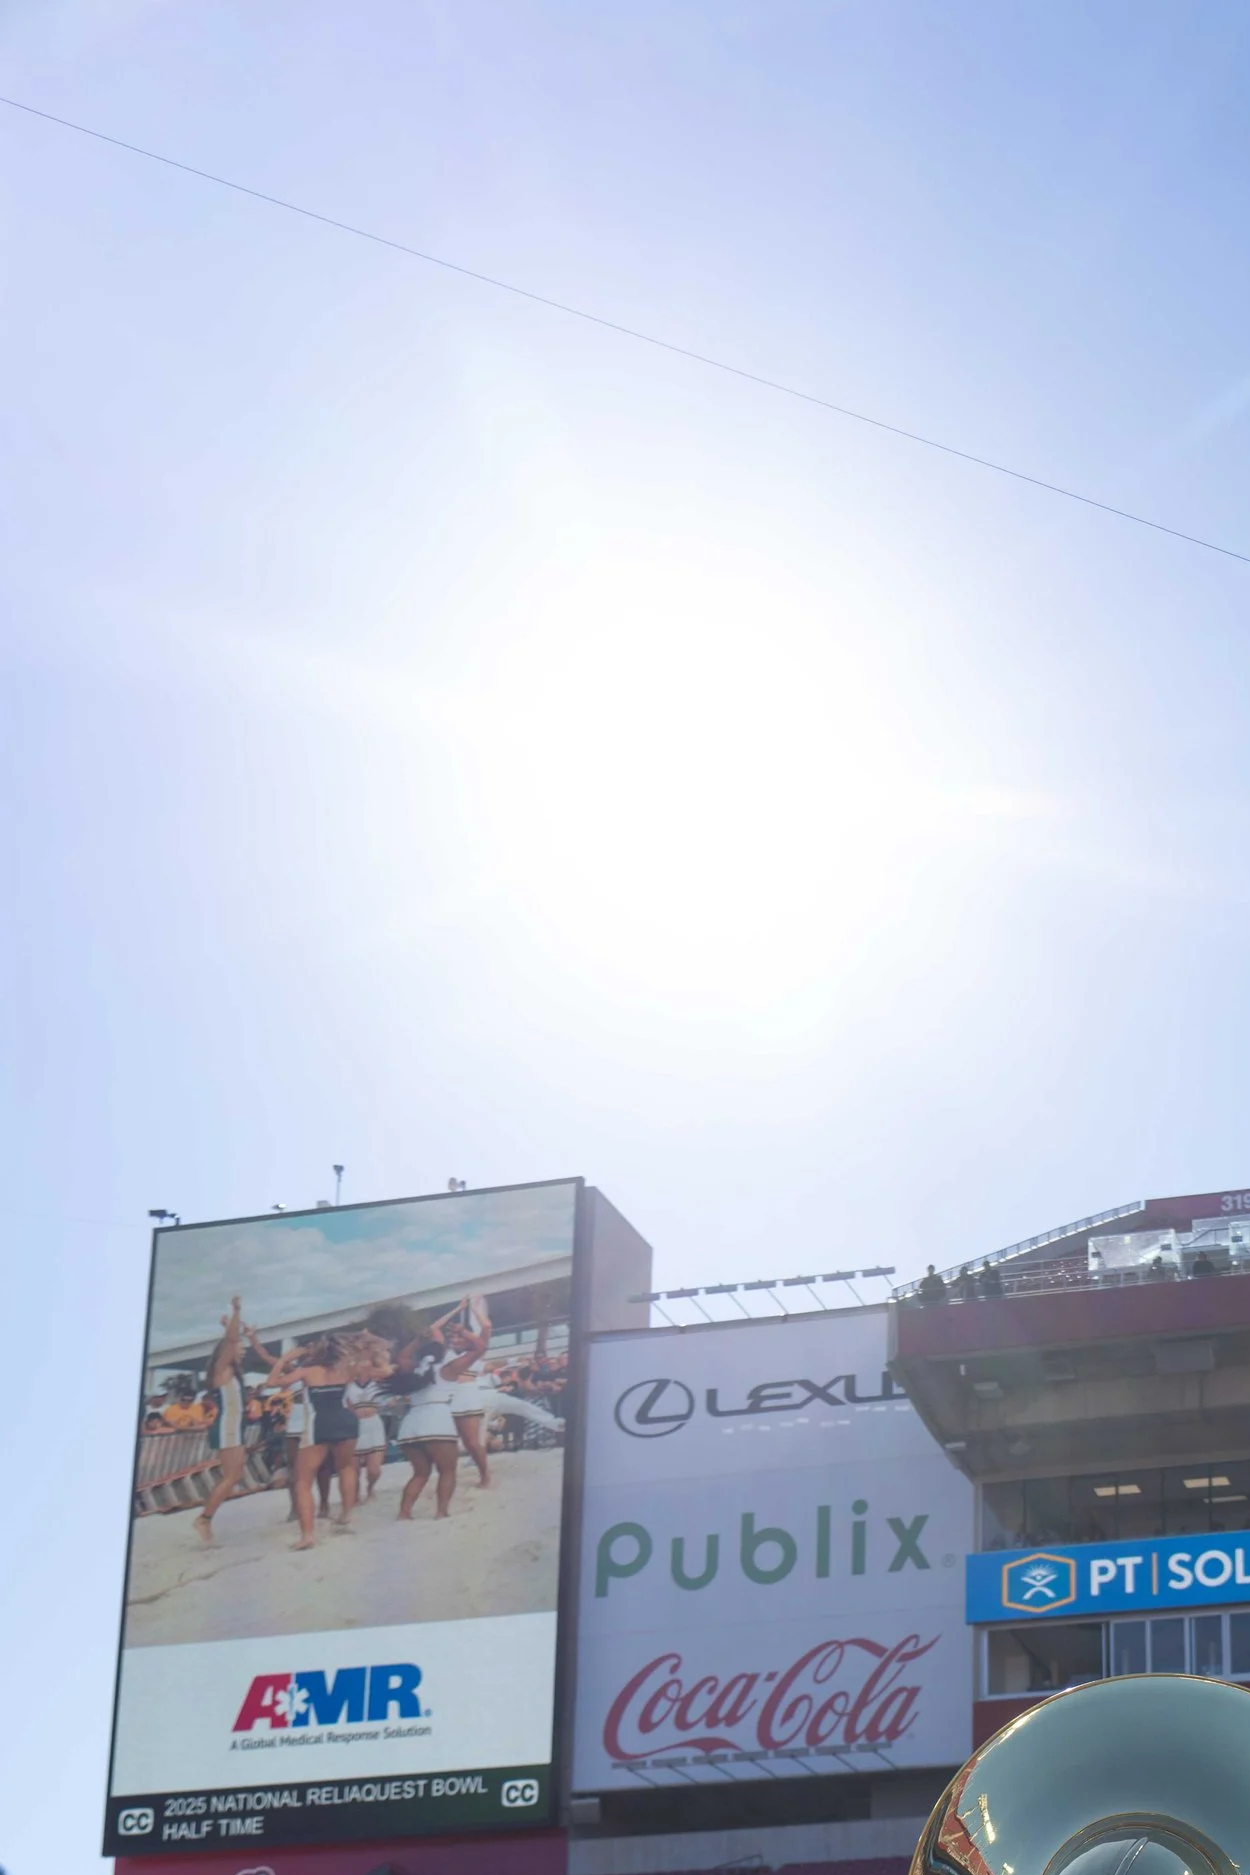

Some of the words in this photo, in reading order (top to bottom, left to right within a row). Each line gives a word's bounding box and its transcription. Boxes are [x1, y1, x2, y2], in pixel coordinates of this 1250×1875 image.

[705, 1371, 910, 1418] LEXU
[595, 1498, 932, 1598] Publix
[1090, 1556, 1143, 1596] PT
[231, 1662, 423, 1733] AMR
[603, 1633, 942, 1761] Coca-Cola
[240, 1736, 277, 1751] Global
[279, 1732, 324, 1747] Medical
[327, 1729, 380, 1745] Response
[383, 1724, 431, 1740] Solution
[163, 1797, 207, 1818] 2025
[210, 1788, 304, 1814] NATIONAL
[306, 1779, 428, 1806] RELIAQUEST
[431, 1775, 488, 1798] BOWL
[505, 1782, 537, 1805] CC
[121, 1811, 151, 1833] CC
[162, 1819, 213, 1842] HALF
[217, 1816, 265, 1838] TIME
